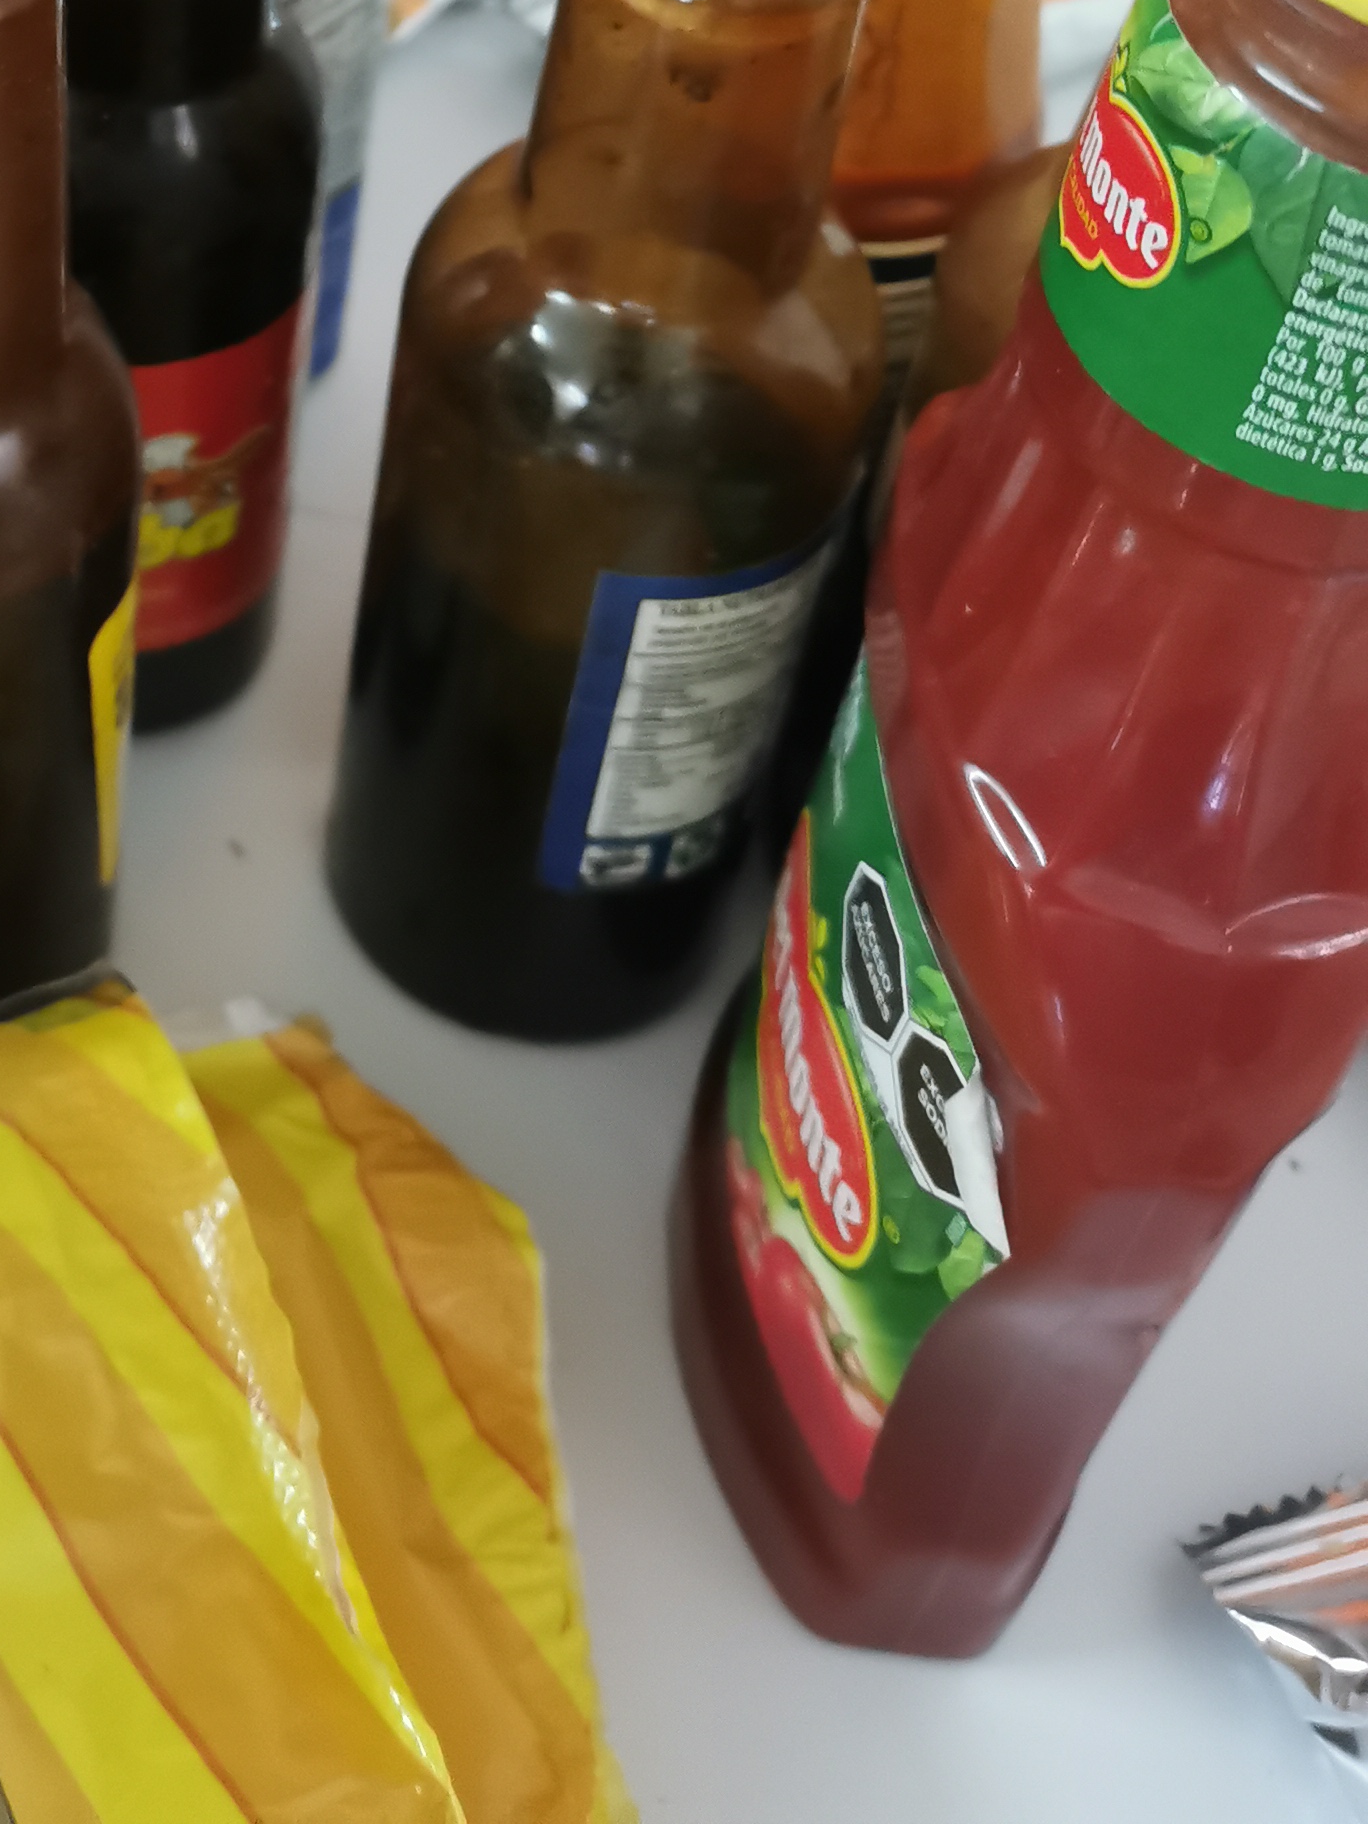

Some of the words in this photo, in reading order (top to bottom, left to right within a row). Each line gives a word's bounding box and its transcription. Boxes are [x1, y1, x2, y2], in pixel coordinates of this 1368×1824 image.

[1300, 269, 1324, 294] de
[1276, 325, 1307, 354] Por
[1315, 338, 1347, 367] 100
[1251, 383, 1266, 402] 0
[1260, 366, 1317, 402] totales
[1235, 420, 1307, 462] dietética
[919, 1062, 946, 1114] EXC
[917, 1087, 949, 1148] SOD
